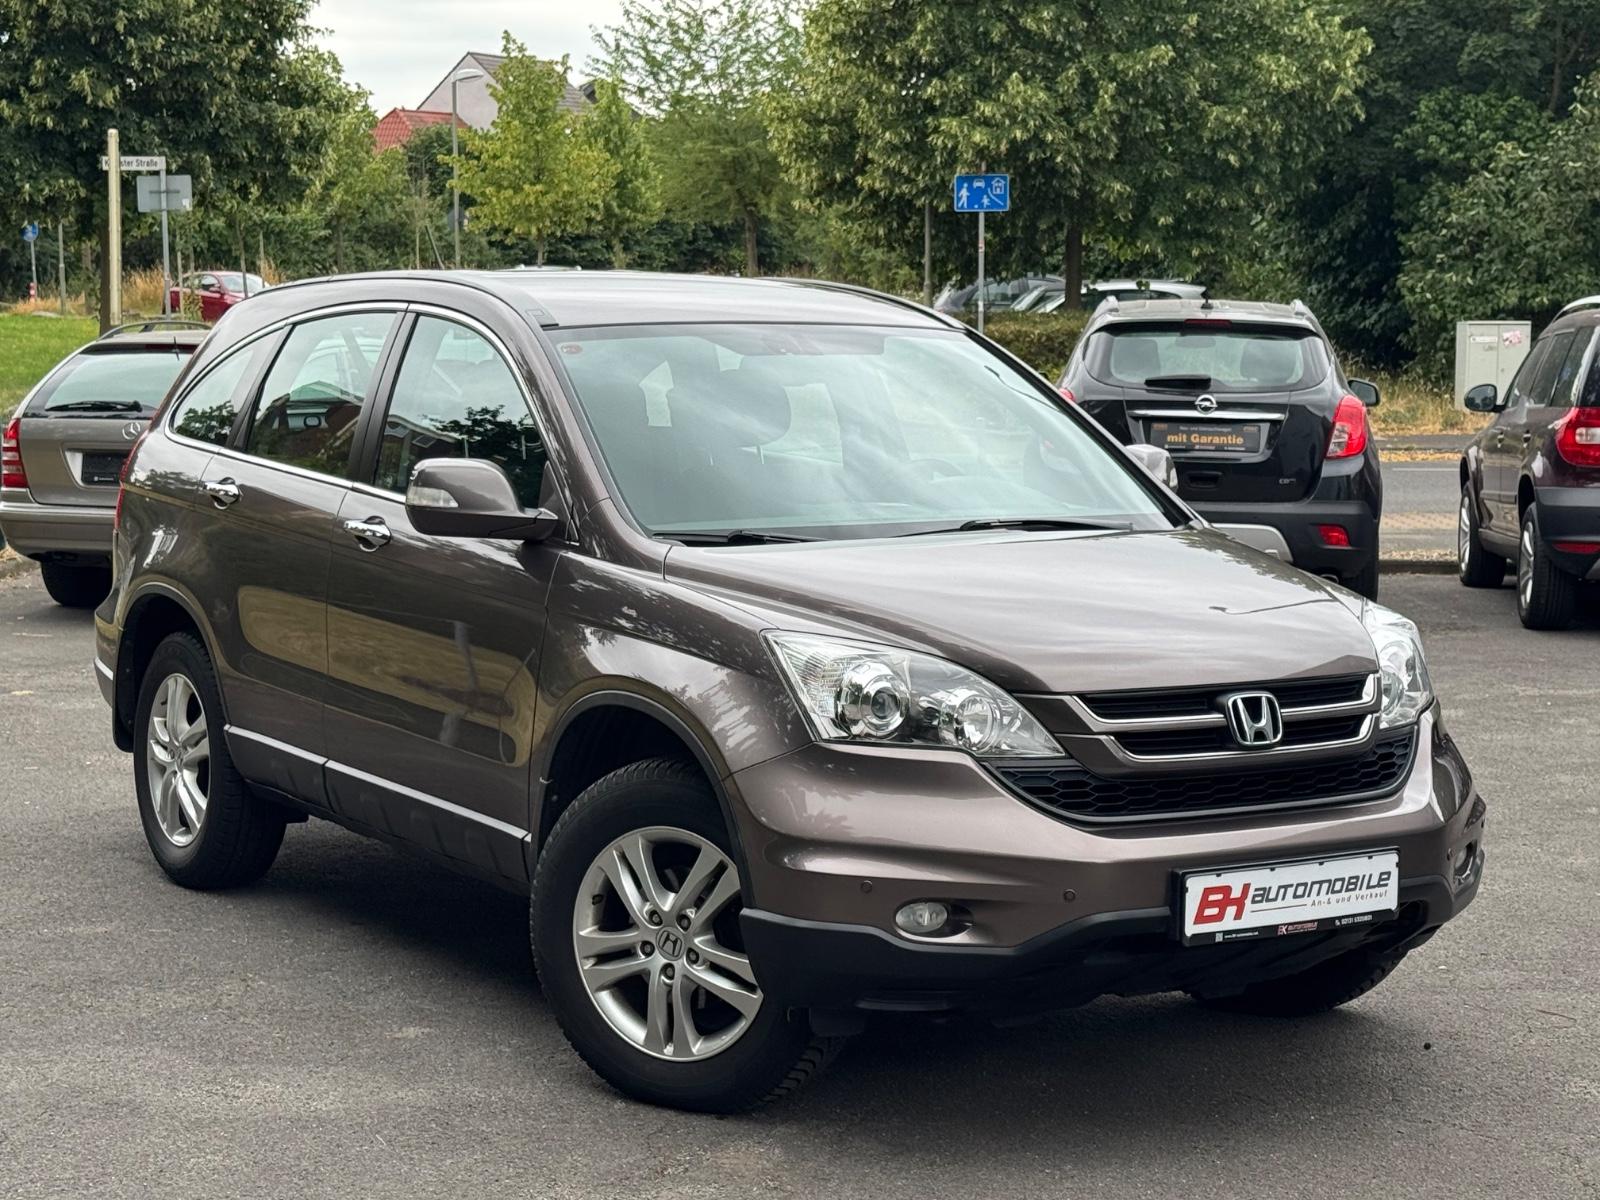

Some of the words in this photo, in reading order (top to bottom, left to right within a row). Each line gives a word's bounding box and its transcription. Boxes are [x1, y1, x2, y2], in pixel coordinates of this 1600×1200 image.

[135, 158, 158, 168] Straße
[1167, 433, 1187, 443] mit
[1190, 433, 1244, 444] Garantie
[1335, 895, 1351, 904] und
[1355, 890, 1388, 901] Verkauf
